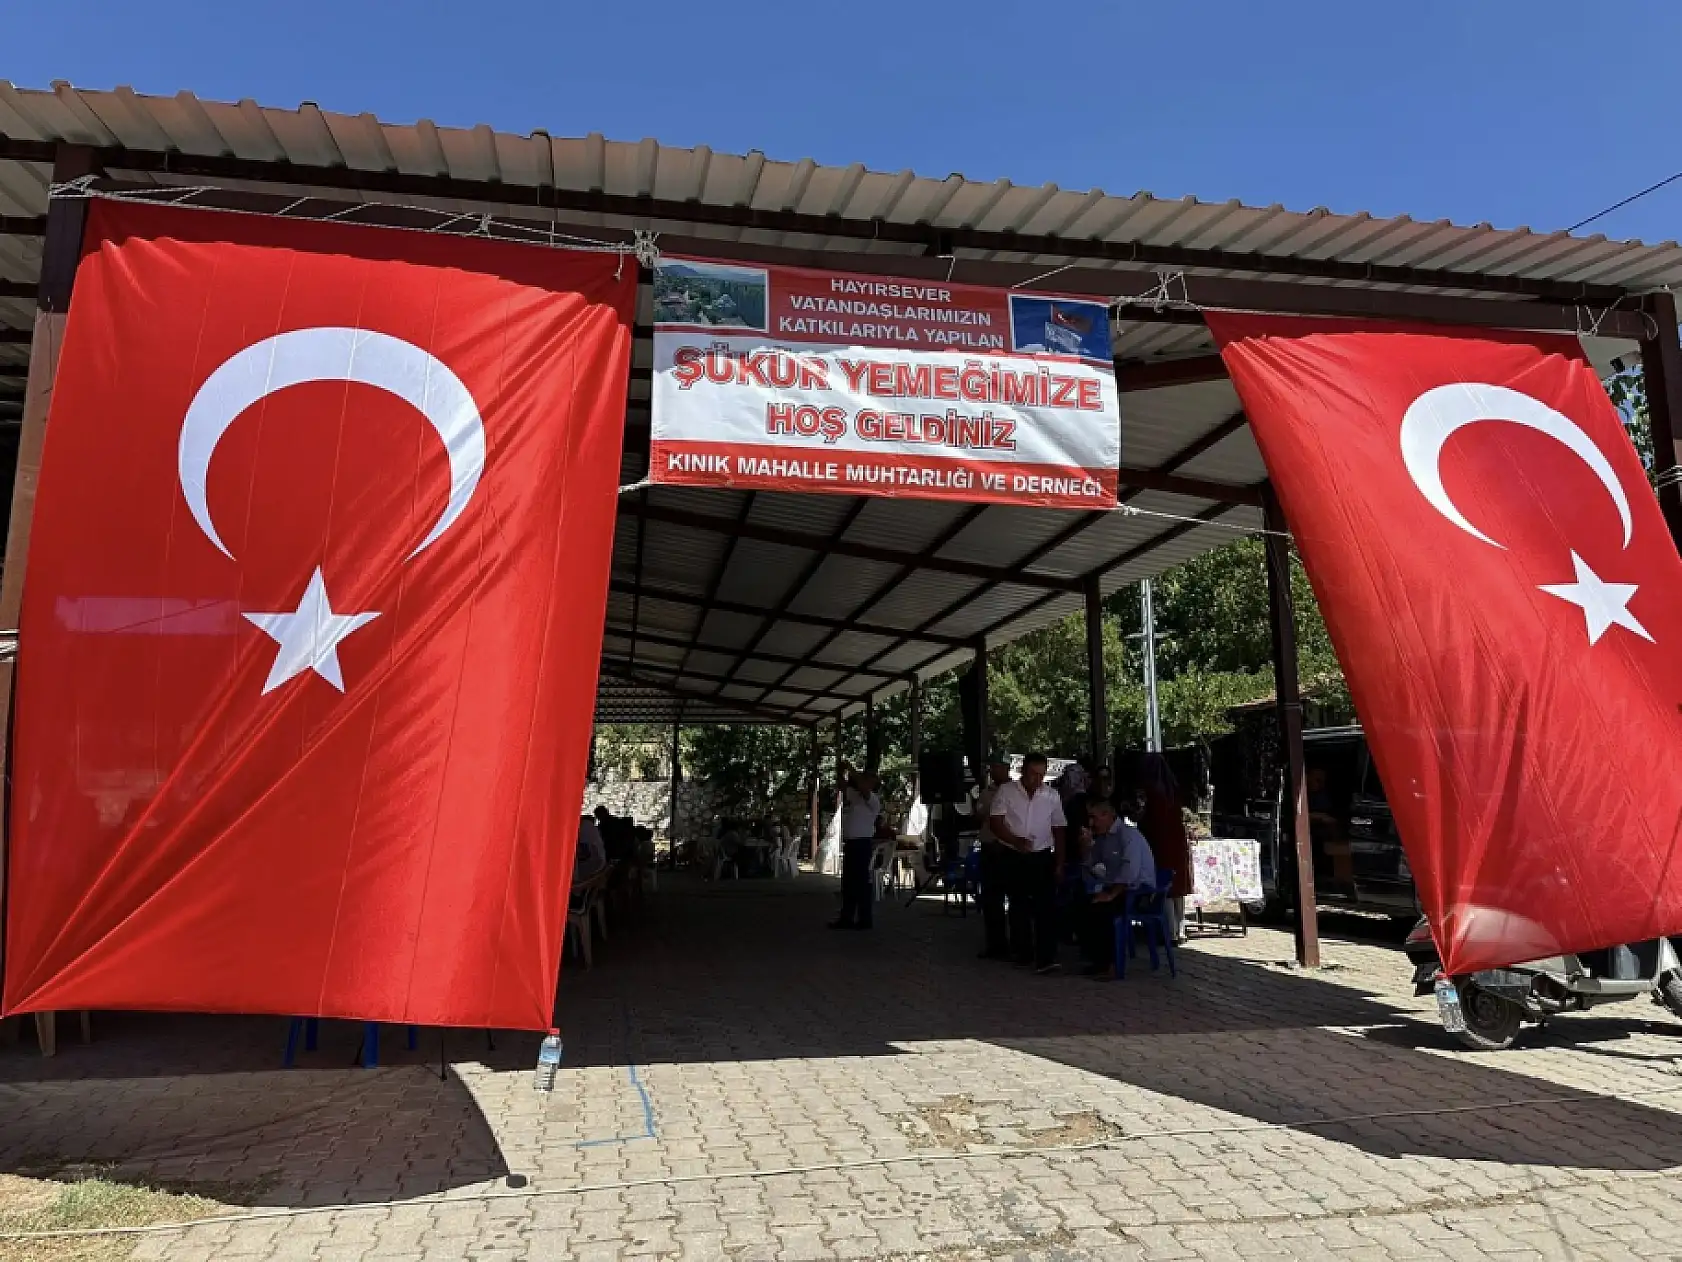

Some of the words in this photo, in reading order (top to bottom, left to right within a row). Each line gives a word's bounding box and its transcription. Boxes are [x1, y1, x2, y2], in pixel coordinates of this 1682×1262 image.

[831, 277, 951, 303] HAYIRSEVER
[790, 294, 992, 327] VATANDAŞLARIMIZIN
[779, 316, 920, 342] KATKILARIYLA
[925, 329, 1004, 348] YAPILAN
[673, 342, 832, 390] ŞÜKÜR
[838, 359, 1104, 411] YEMEĞİMİZE
[766, 402, 847, 443] HOŞ
[855, 409, 1016, 450] GELDİNİZ
[667, 452, 731, 475] KINIK
[737, 459, 838, 481] MAHALLE
[845, 463, 974, 488] MUHTARLIĞI
[981, 474, 1007, 491] VE
[1013, 474, 1102, 496] DERNEĞİ
